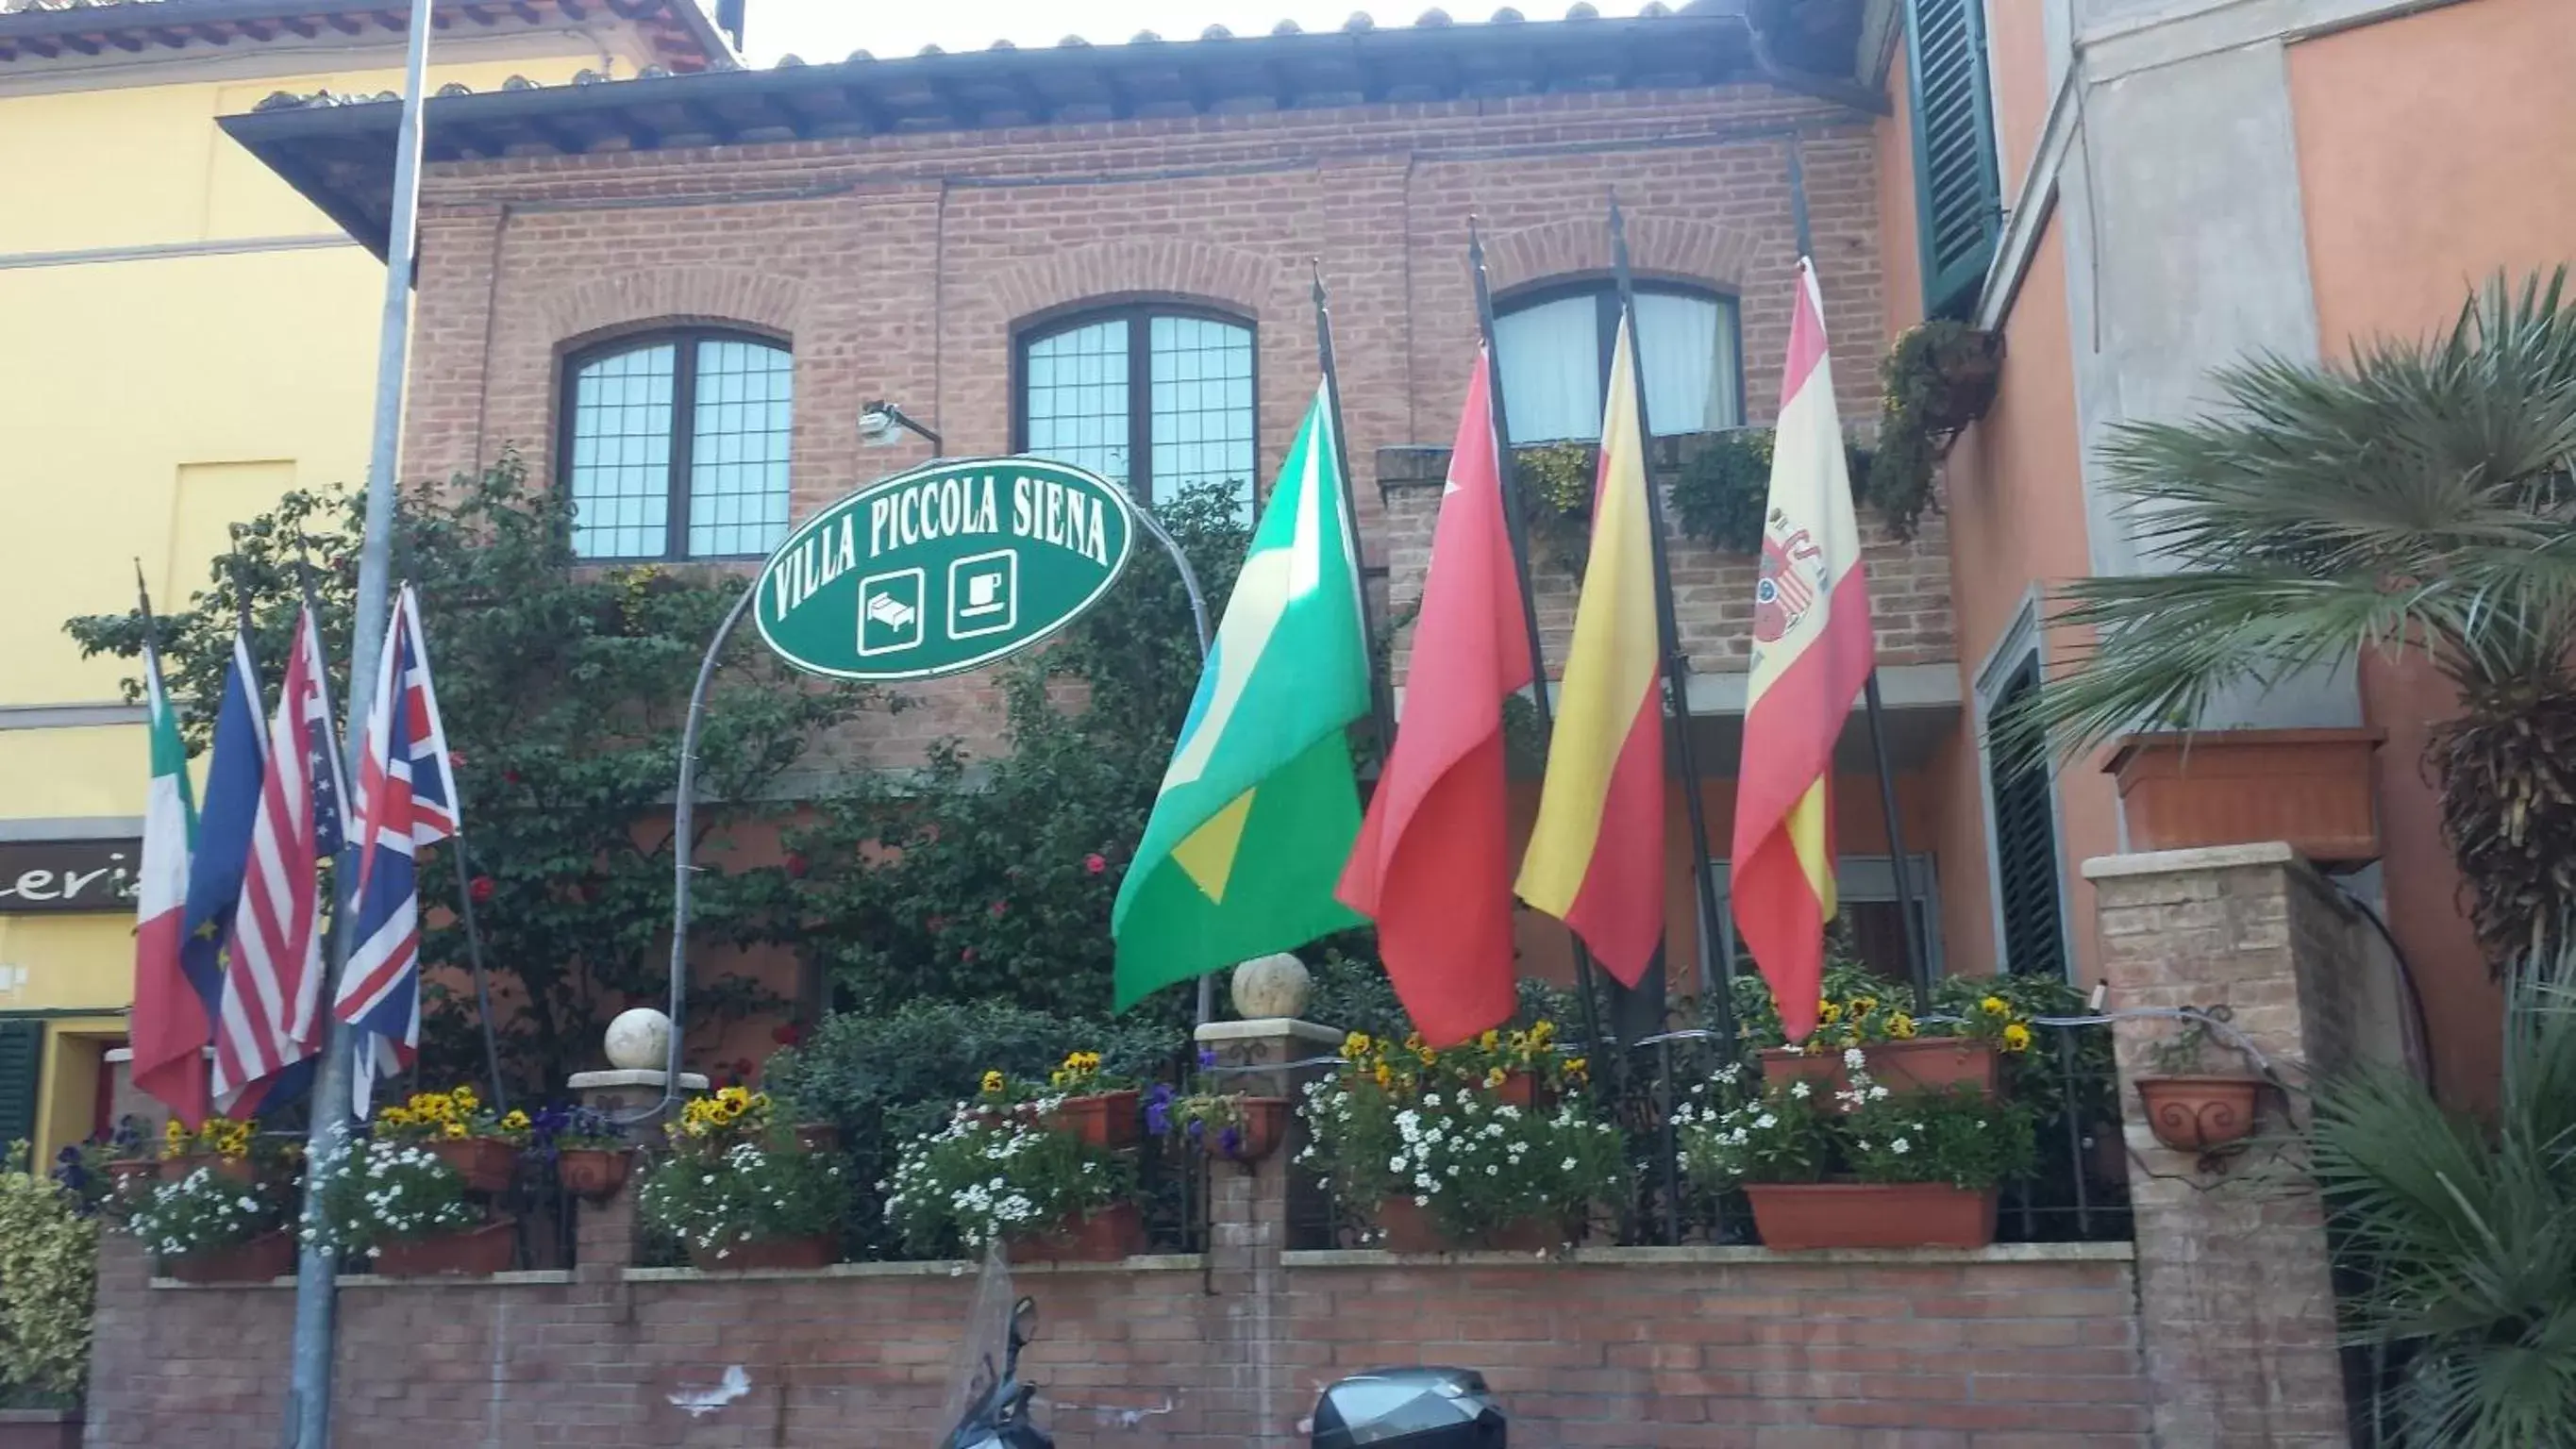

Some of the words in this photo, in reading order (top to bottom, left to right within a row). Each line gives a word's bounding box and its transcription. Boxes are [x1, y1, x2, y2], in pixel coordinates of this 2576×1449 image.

[774, 513, 857, 623] VILLA
[870, 475, 998, 558] PICCOLA
[1012, 476, 1108, 567] SIENA
[0, 852, 142, 900] eri
